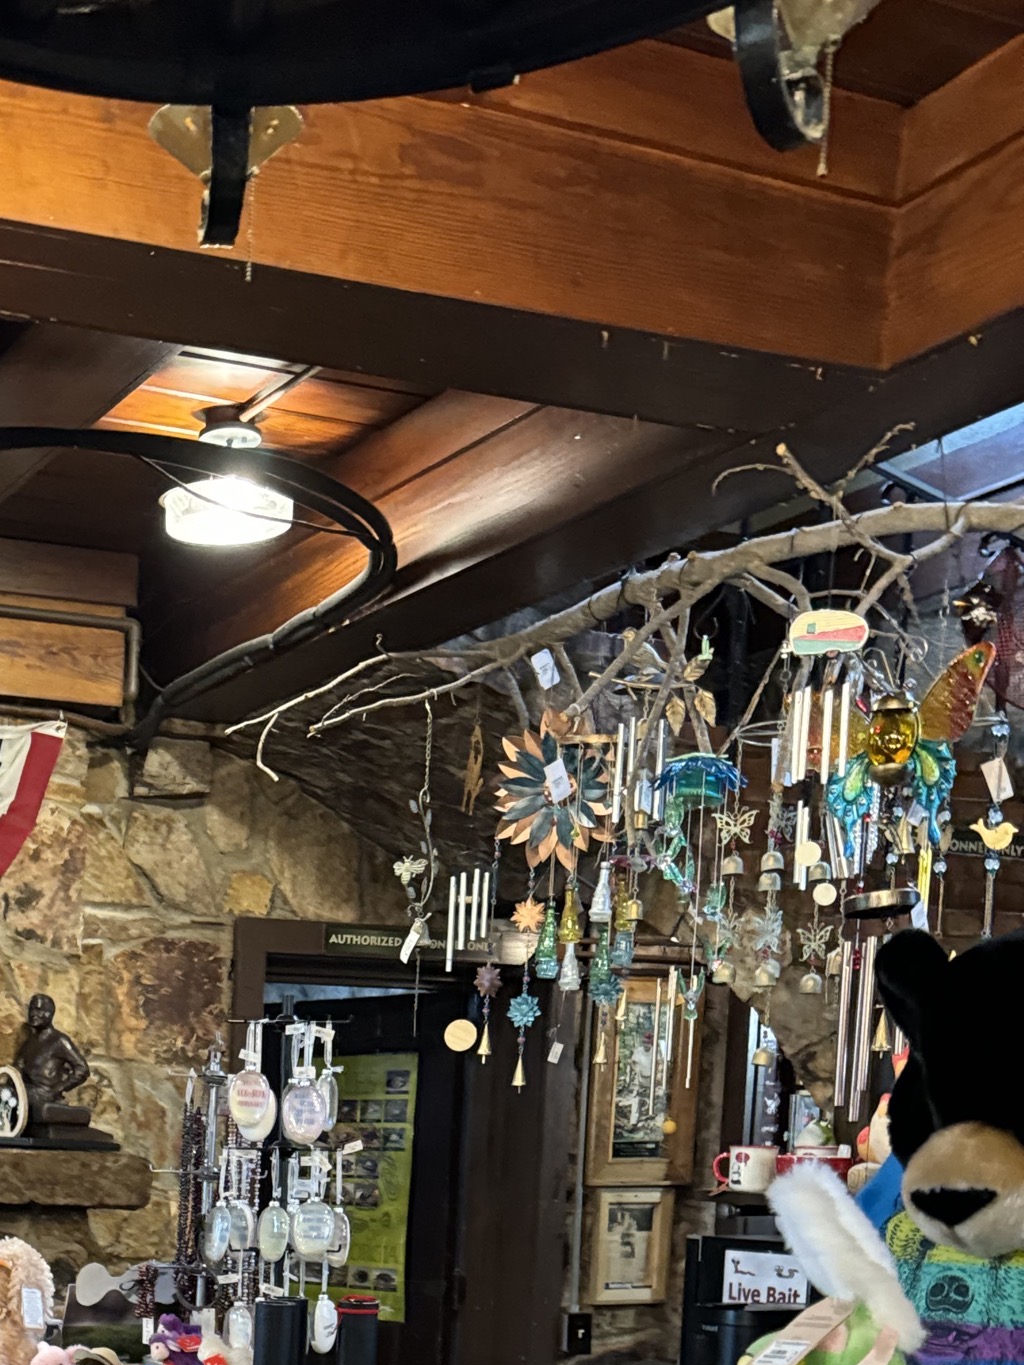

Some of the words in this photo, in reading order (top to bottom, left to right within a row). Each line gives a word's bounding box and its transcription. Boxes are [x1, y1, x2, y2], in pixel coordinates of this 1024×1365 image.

[329, 933, 402, 947] AUTHORIZED
[728, 1282, 761, 1302] Live
[767, 1286, 801, 1304] Bait
